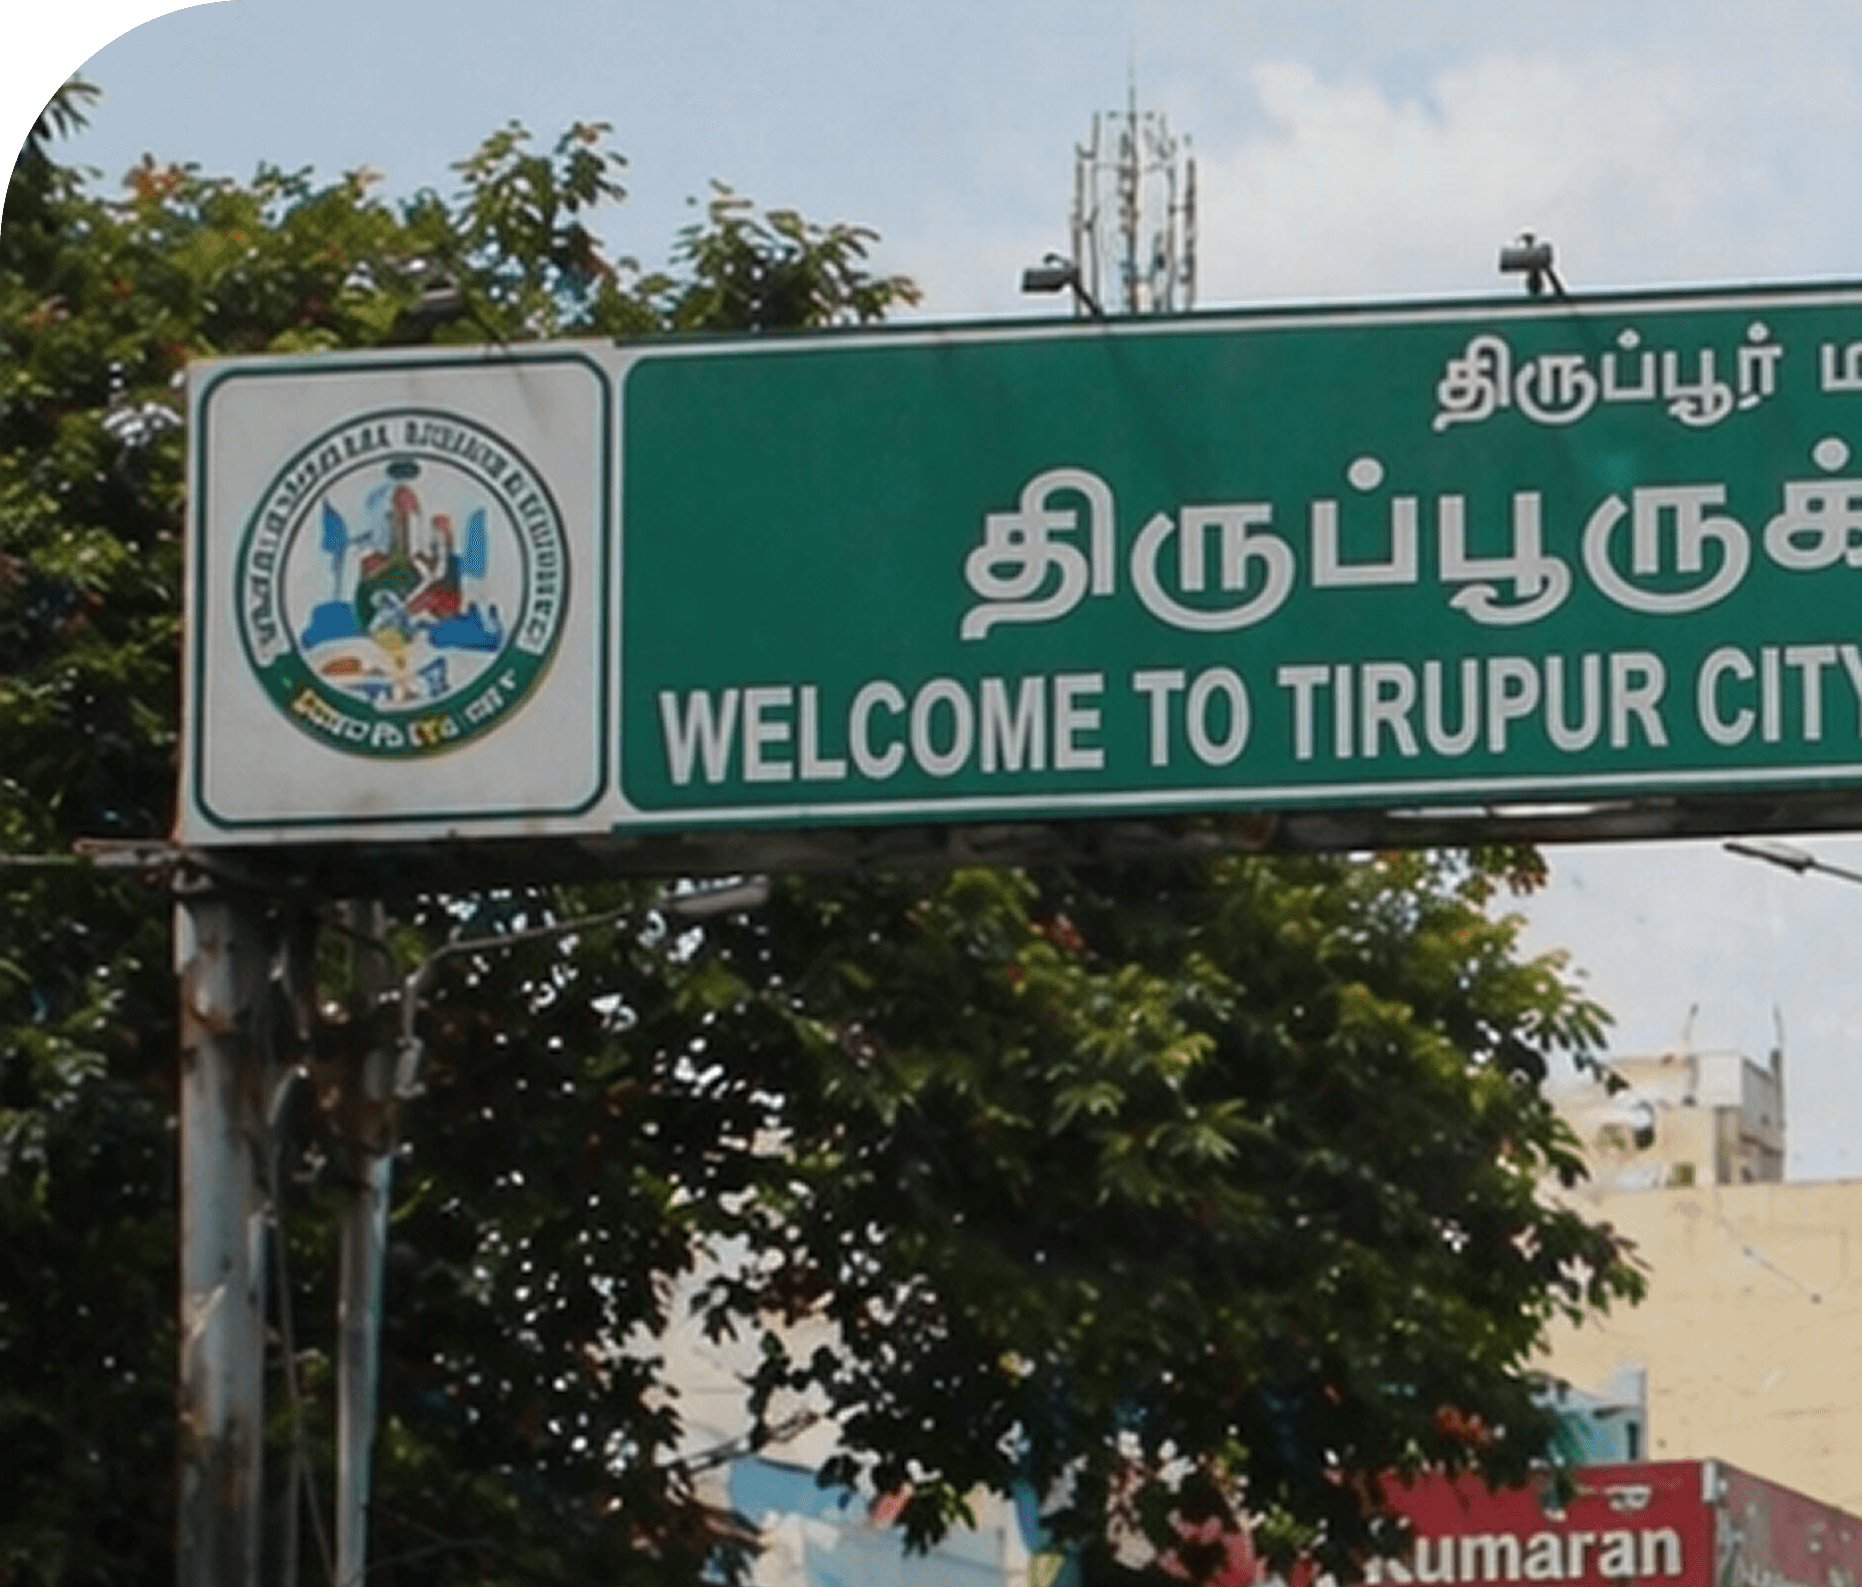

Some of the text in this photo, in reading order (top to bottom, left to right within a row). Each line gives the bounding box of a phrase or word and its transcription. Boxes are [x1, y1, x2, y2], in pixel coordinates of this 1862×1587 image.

[1432, 320, 1784, 431] திருப்பூர்
[659, 672, 1105, 786] WELCOME
[1132, 666, 1251, 767] TO
[1276, 650, 1669, 761] TIRUPUR
